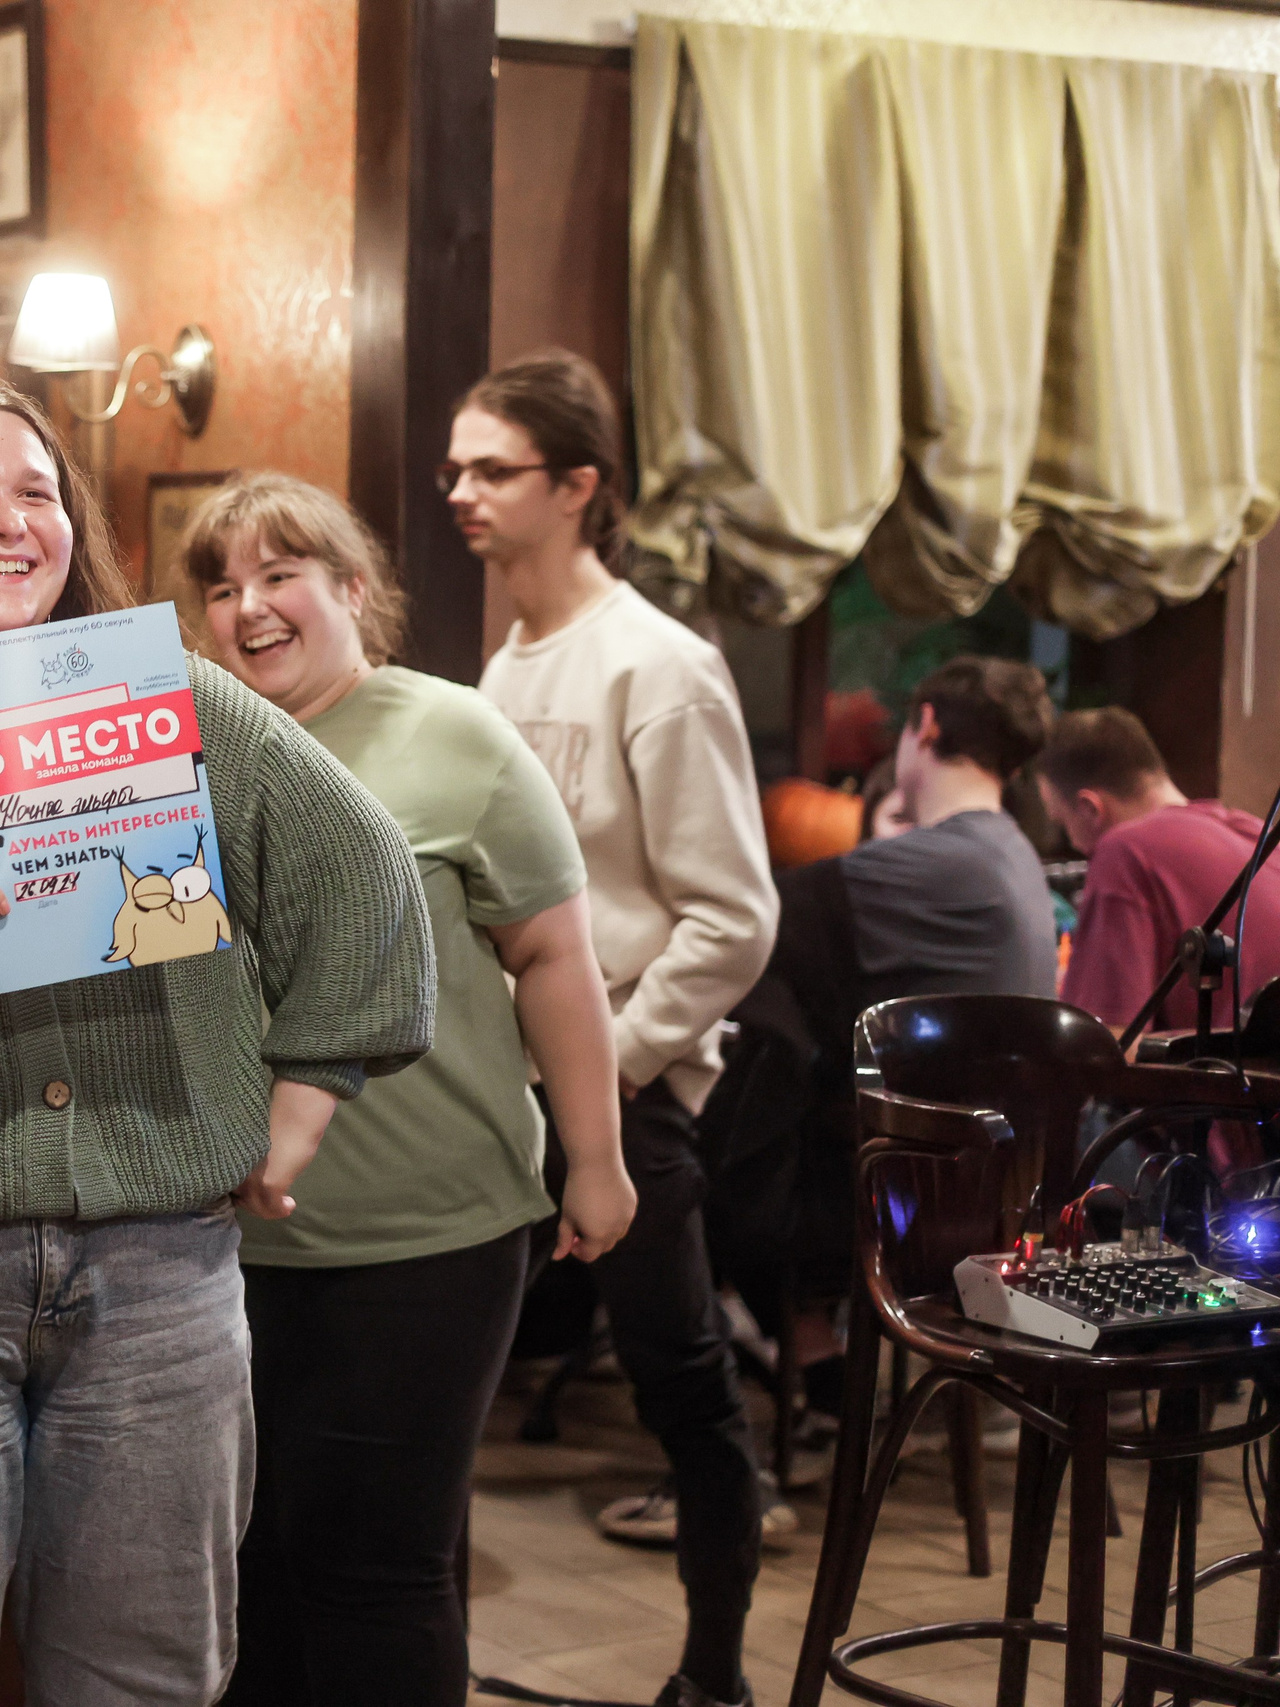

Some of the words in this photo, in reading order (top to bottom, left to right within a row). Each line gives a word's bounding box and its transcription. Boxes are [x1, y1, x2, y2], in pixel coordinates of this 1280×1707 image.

[69, 622, 89, 636] клуб
[90, 620, 103, 630] 60
[104, 616, 134, 630] секунд
[71, 654, 85, 668] 60
[20, 708, 182, 771] МЕСТО
[35, 760, 80, 780] заняла
[81, 753, 135, 774] команда
[8, 829, 80, 857] ДУМАТЬ
[85, 804, 206, 840] ИНТЕРЕСНЕЕ,
[11, 856, 49, 876] ЧЕМ
[55, 845, 111, 869] ЗНАТЬ
